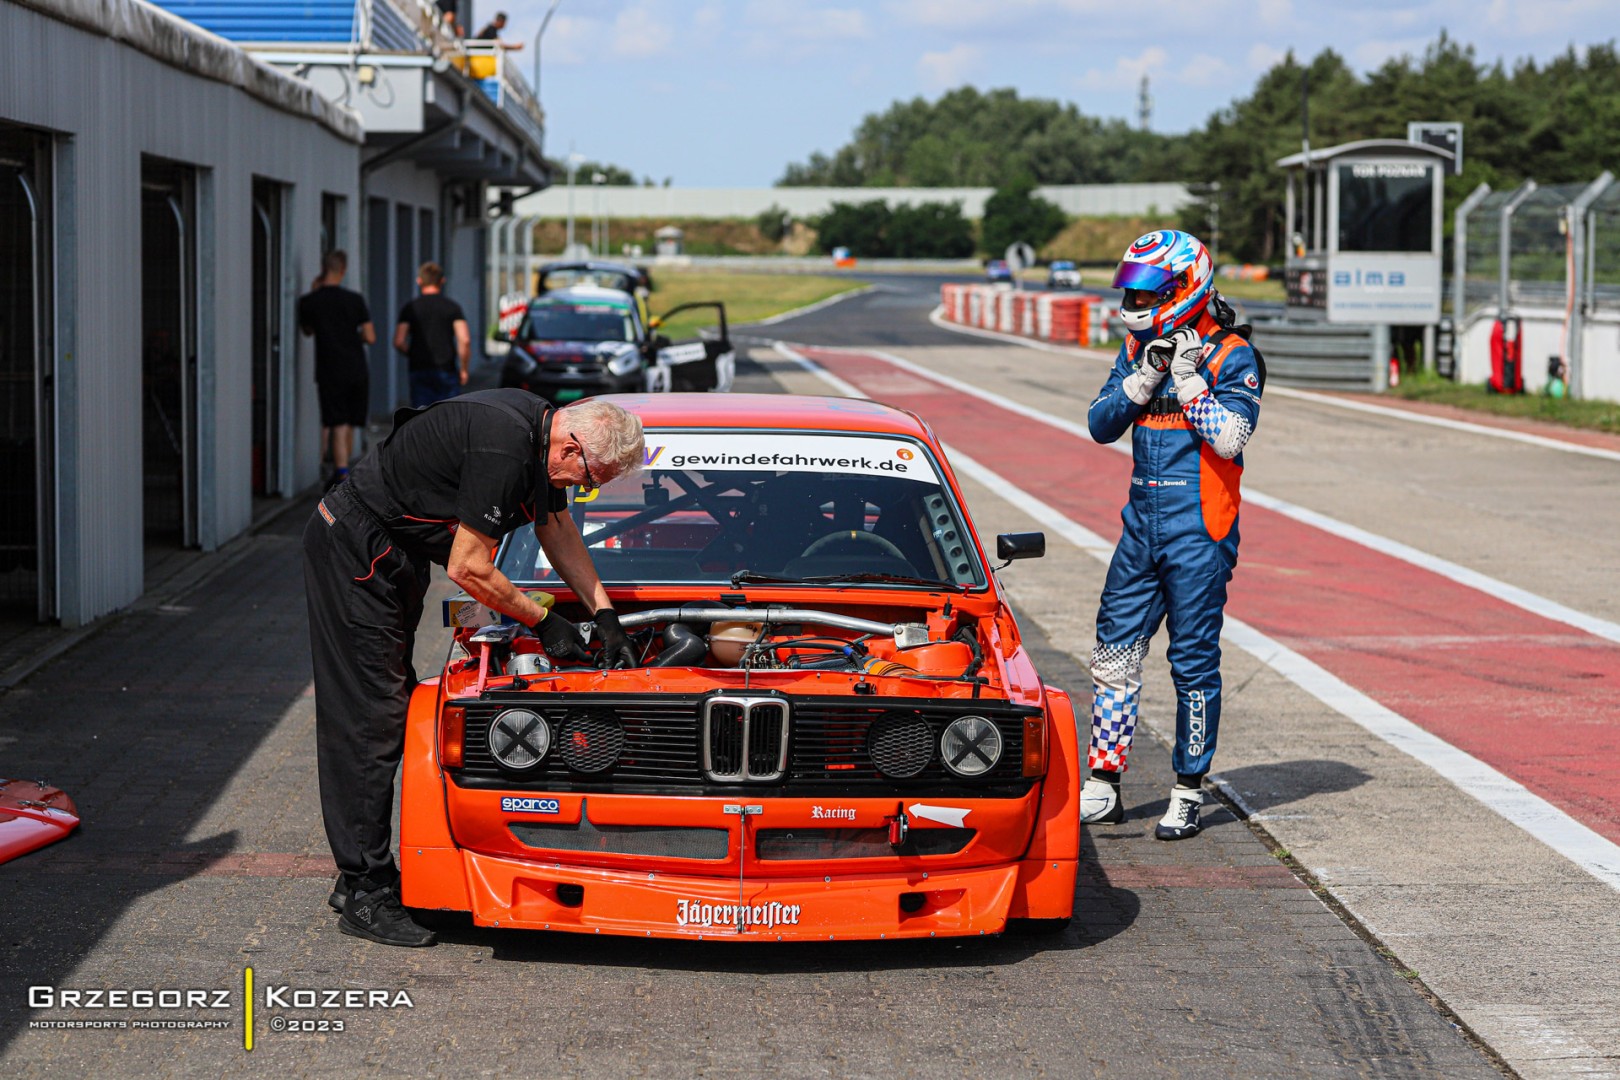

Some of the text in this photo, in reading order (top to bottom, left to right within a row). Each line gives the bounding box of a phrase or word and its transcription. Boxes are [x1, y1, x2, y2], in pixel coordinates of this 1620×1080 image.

[671, 453, 908, 473] gewindefahrwerk.de
[1188, 690, 1206, 756] sparco
[502, 797, 560, 812] sparco
[811, 805, 857, 821] Racing
